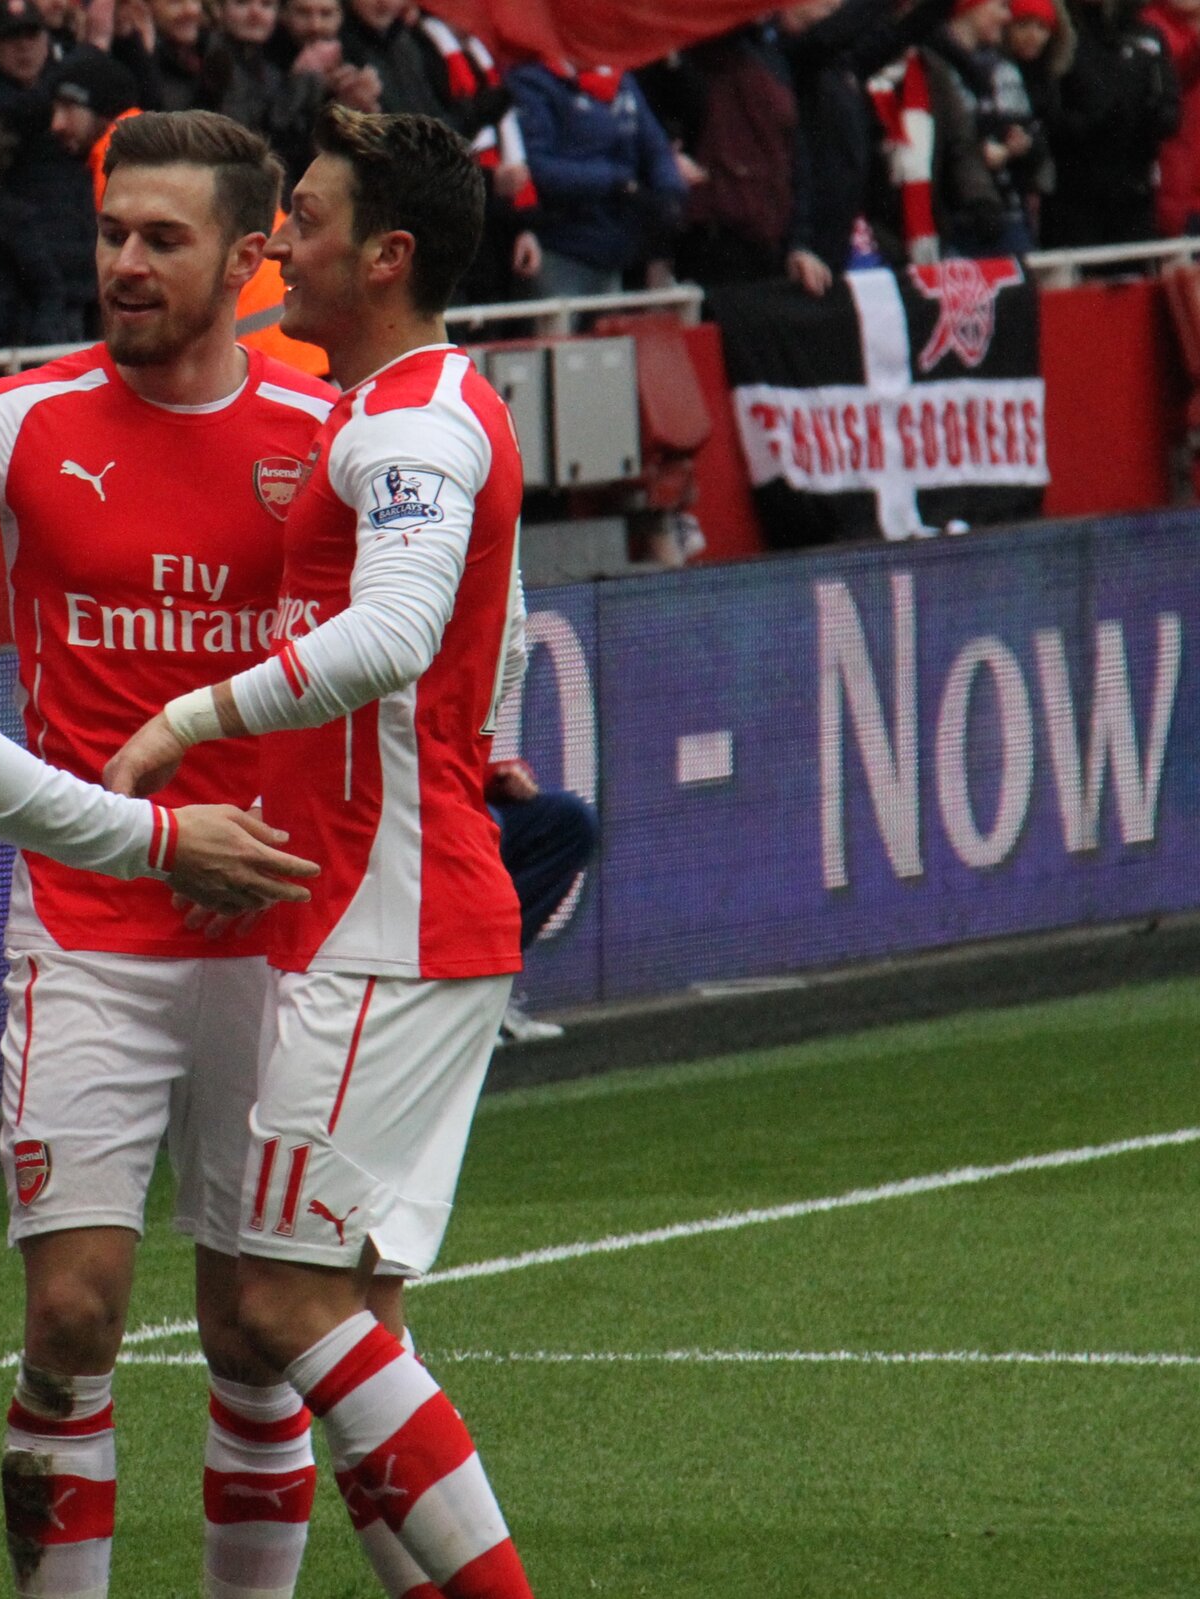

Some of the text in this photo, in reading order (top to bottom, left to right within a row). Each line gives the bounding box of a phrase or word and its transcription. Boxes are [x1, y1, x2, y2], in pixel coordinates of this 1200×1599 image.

[261, 467, 300, 478] Arsenal
[379, 503, 423, 519] BARCLAYS
[152, 553, 229, 601] Fly
[65, 592, 279, 652] Emirate
[249, 1135, 312, 1237] 11
